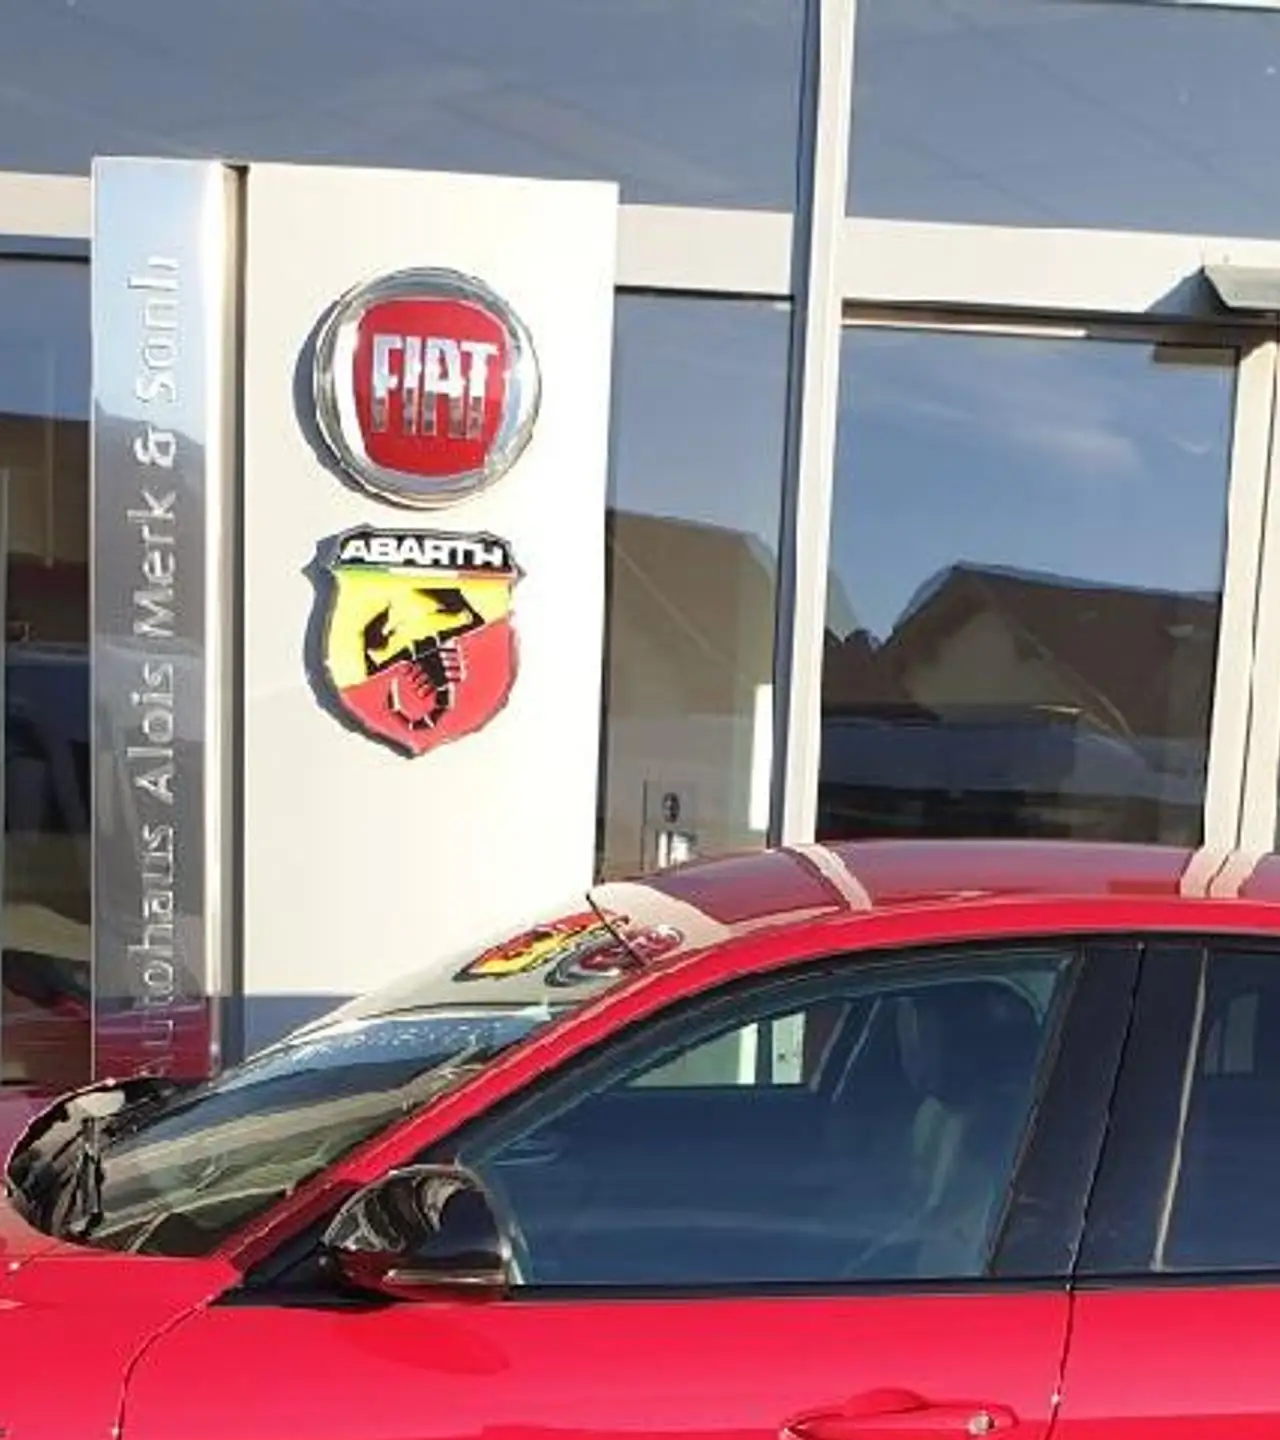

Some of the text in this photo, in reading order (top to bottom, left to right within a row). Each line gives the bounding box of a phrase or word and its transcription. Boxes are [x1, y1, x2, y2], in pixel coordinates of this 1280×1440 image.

[370, 332, 500, 441] FIAT
[133, 422, 178, 469] &
[126, 489, 177, 639] Merk
[338, 537, 504, 567] ABARTH
[126, 659, 175, 806] Alois
